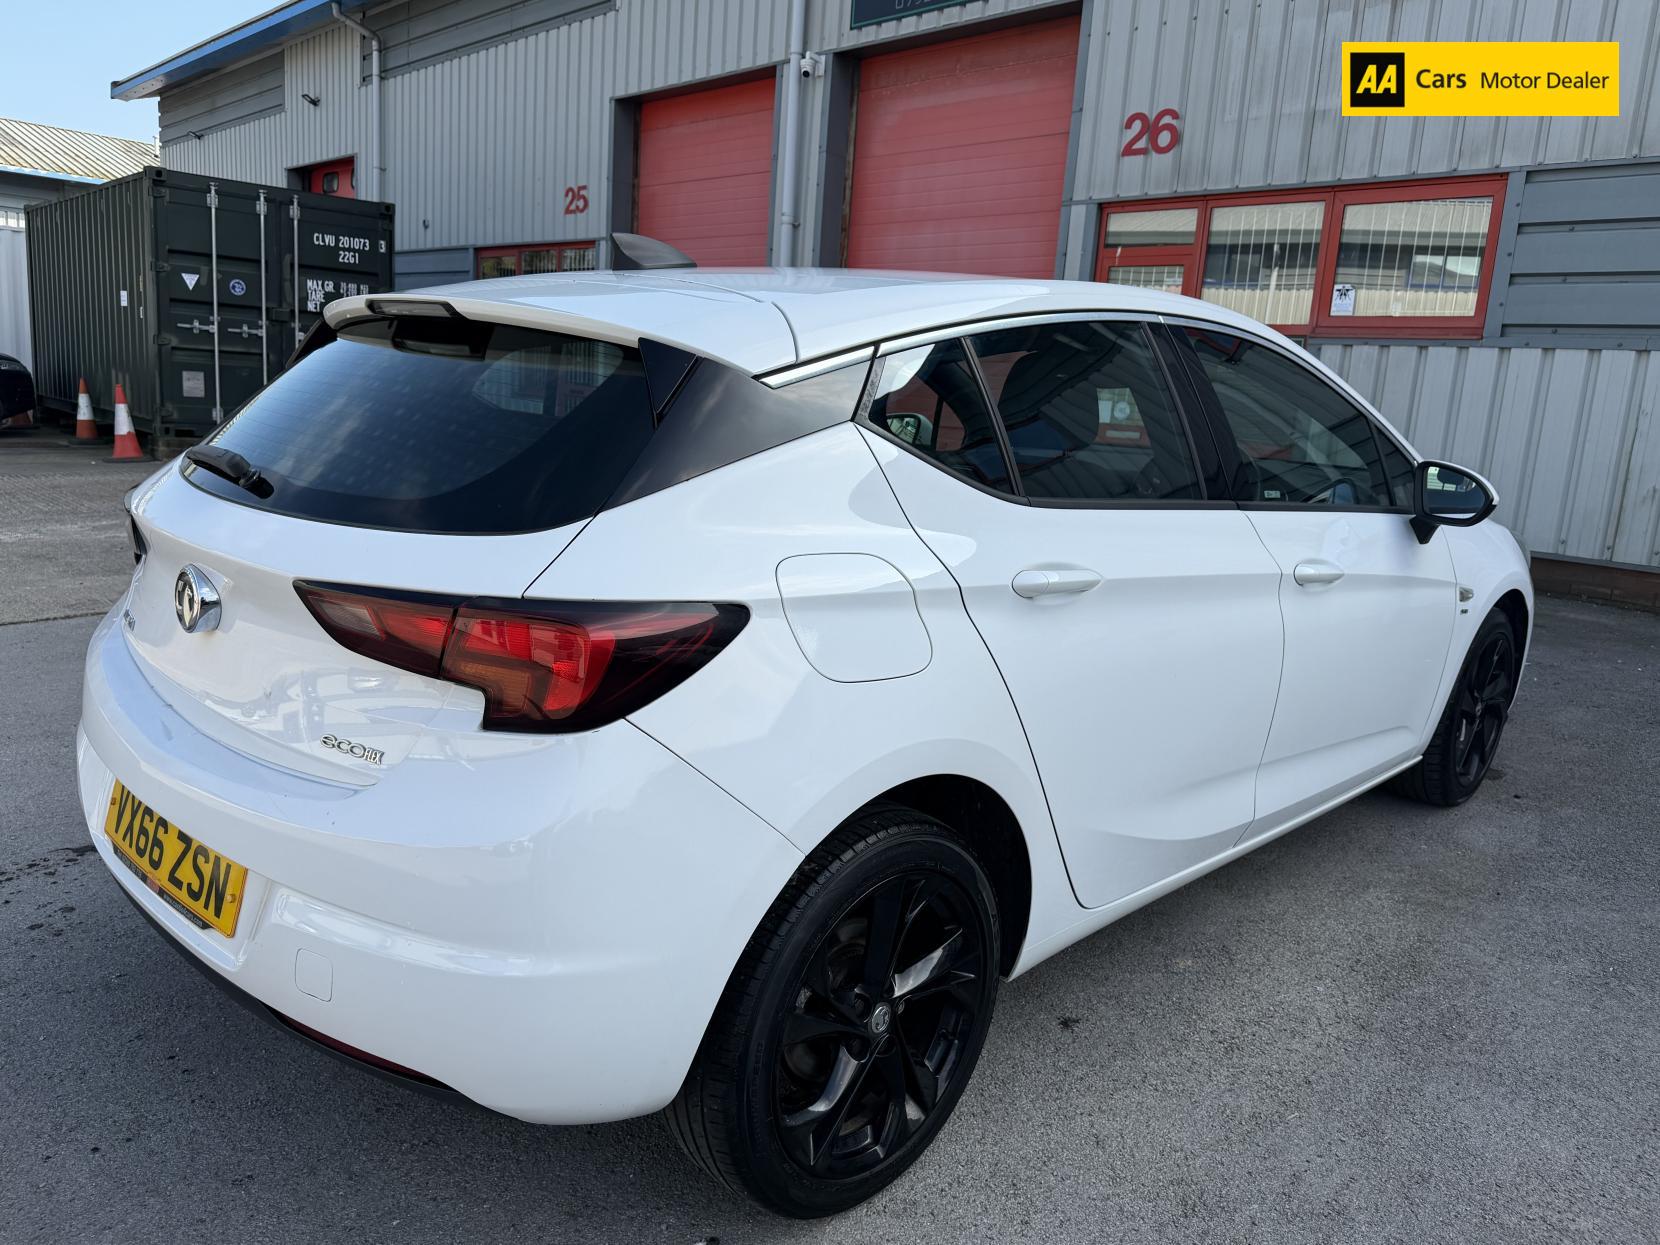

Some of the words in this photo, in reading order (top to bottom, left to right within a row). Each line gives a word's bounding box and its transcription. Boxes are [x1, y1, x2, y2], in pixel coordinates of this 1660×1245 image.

[1121, 108, 1180, 157] 26
[564, 185, 589, 215] 25
[313, 232, 336, 247] CLVU
[338, 235, 370, 251] 201073
[379, 240, 387, 253] 3
[338, 251, 359, 264] 22G1
[306, 279, 323, 292] MAX
[307, 290, 326, 303] TARE
[307, 301, 321, 312] NET
[115, 784, 169, 871] VX66
[167, 829, 232, 919] ZSN
